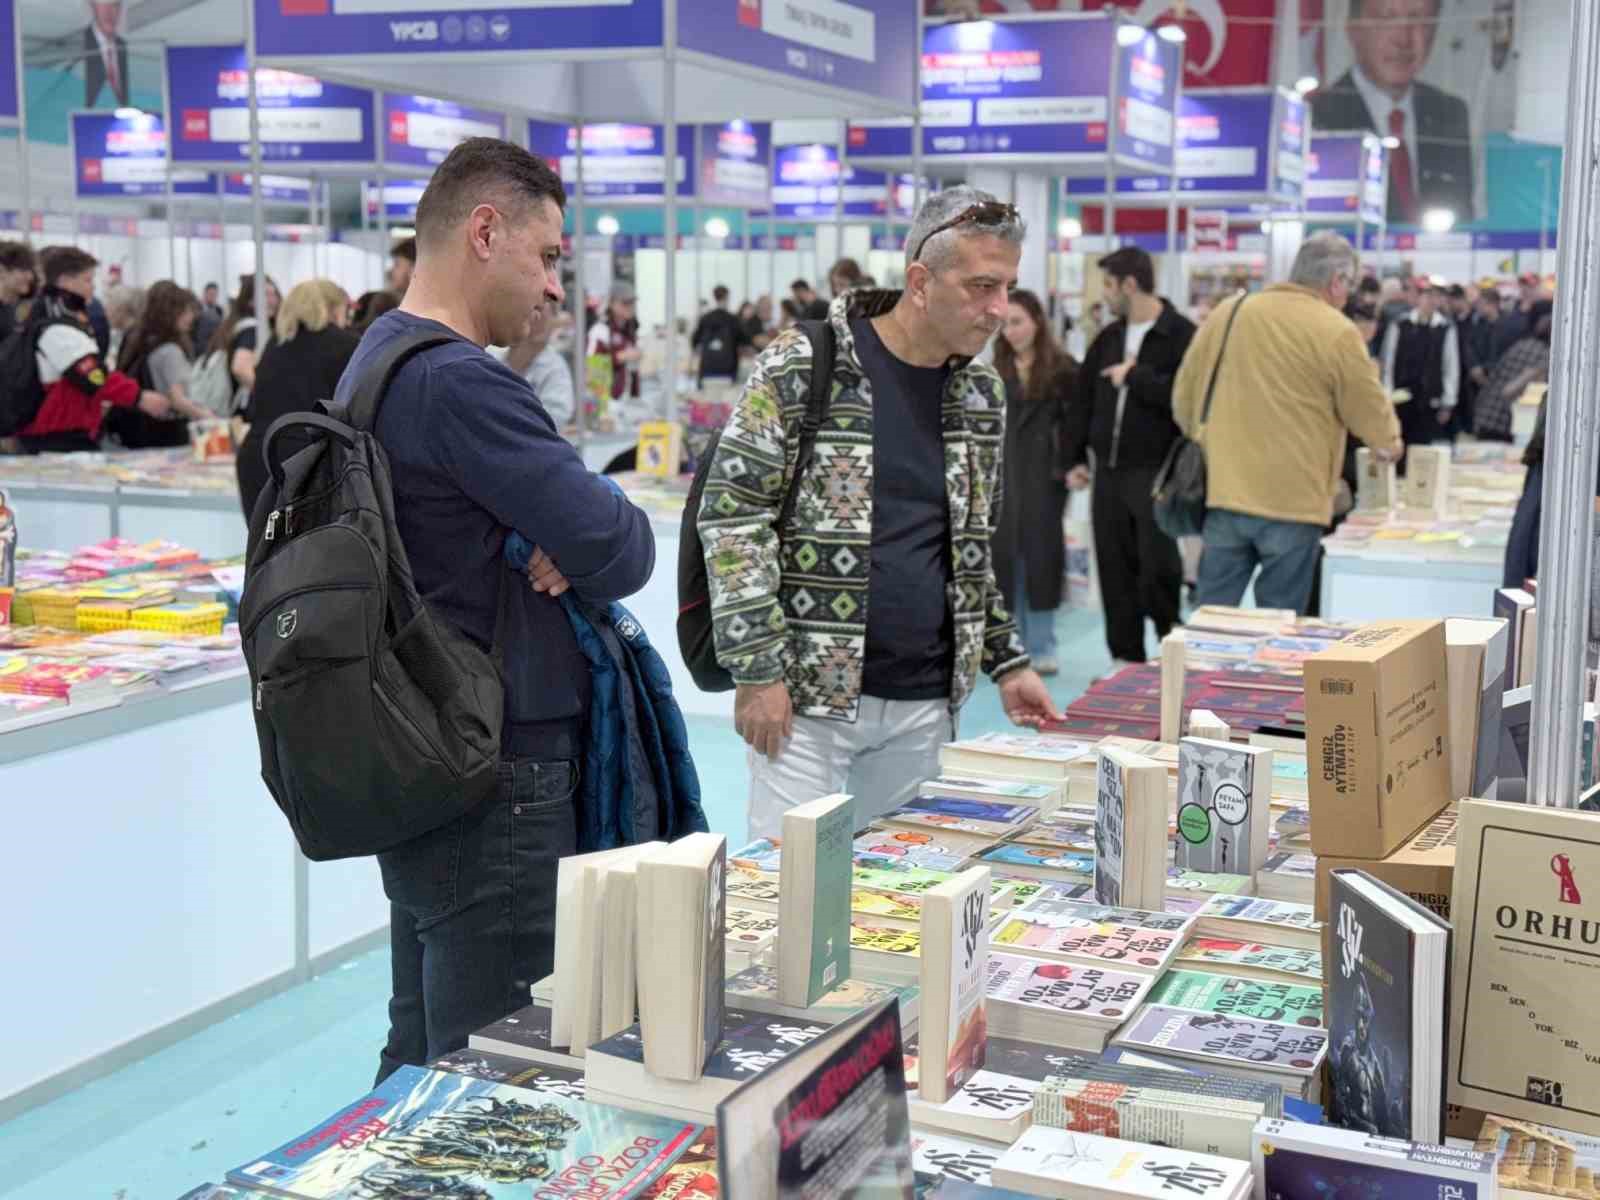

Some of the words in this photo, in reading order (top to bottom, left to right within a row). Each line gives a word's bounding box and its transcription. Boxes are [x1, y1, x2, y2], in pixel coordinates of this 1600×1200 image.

[1335, 725, 1346, 793] AYTMATOV
[1045, 981, 1074, 999] MA
[1076, 969, 1104, 990] AYT
[1019, 985, 1049, 1003] TOV
[1111, 982, 1141, 1003] CEN
